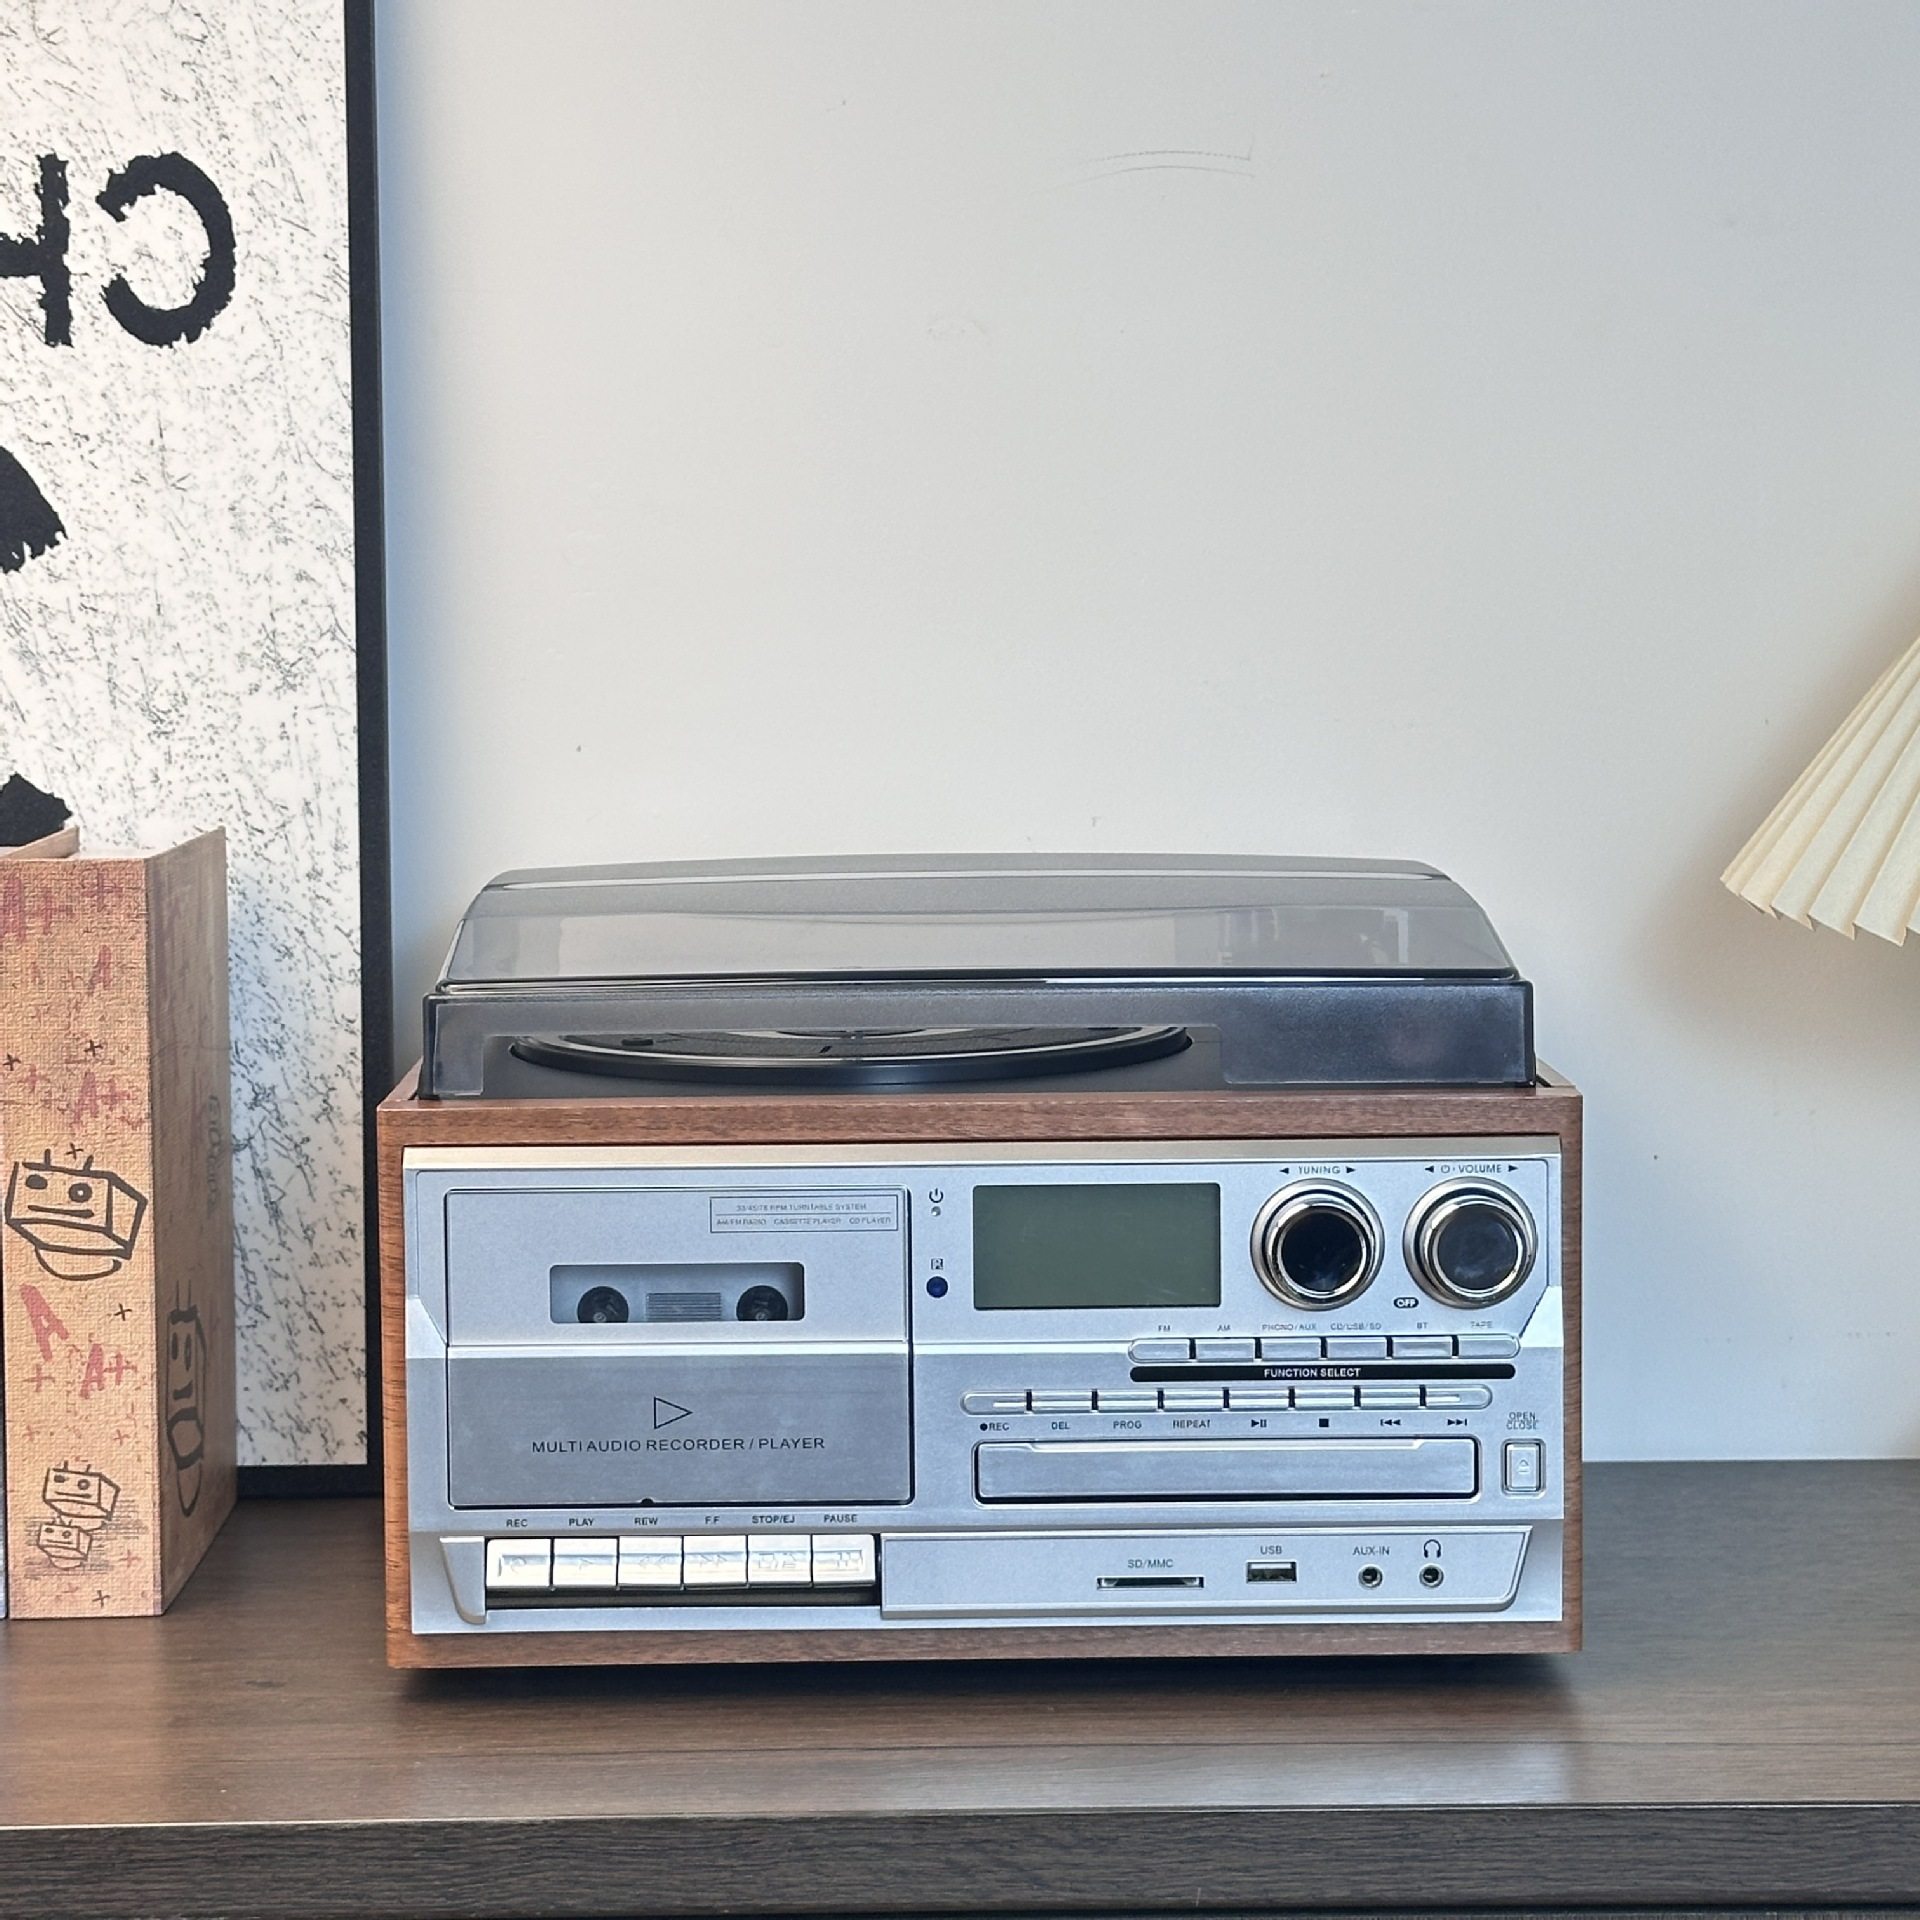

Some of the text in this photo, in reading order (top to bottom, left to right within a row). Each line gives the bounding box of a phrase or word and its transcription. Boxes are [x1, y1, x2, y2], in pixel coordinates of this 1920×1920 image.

[1298, 1166, 1341, 1175] TUNING
[1459, 1164, 1502, 1173] VOLUME
[1397, 1298, 1416, 1308] OFF
[20, 1284, 69, 1362] A
[1157, 1323, 1171, 1332] FM
[1217, 1323, 1231, 1332] AM
[1263, 1366, 1361, 1378] FUNCTION SELECT
[1508, 1411, 1536, 1421] OPEN
[989, 1422, 1010, 1431] REC
[1051, 1421, 1070, 1430] DEL
[1113, 1420, 1142, 1430] PROG
[1172, 1419, 1211, 1429] REPEAT
[532, 1440, 582, 1453] MULTI
[587, 1439, 641, 1452] AUDIO
[646, 1438, 744, 1451] RECORDER
[758, 1437, 825, 1450] PLAYER
[505, 1518, 529, 1528] REC
[568, 1517, 595, 1527] PLAY
[634, 1516, 659, 1526] REW
[752, 1514, 796, 1524] STOP/EJ
[823, 1513, 858, 1523] PAUSE
[1260, 1545, 1283, 1555] USB
[1353, 1545, 1390, 1556] AUX-IN
[1127, 1558, 1174, 1569] SD/MMC
